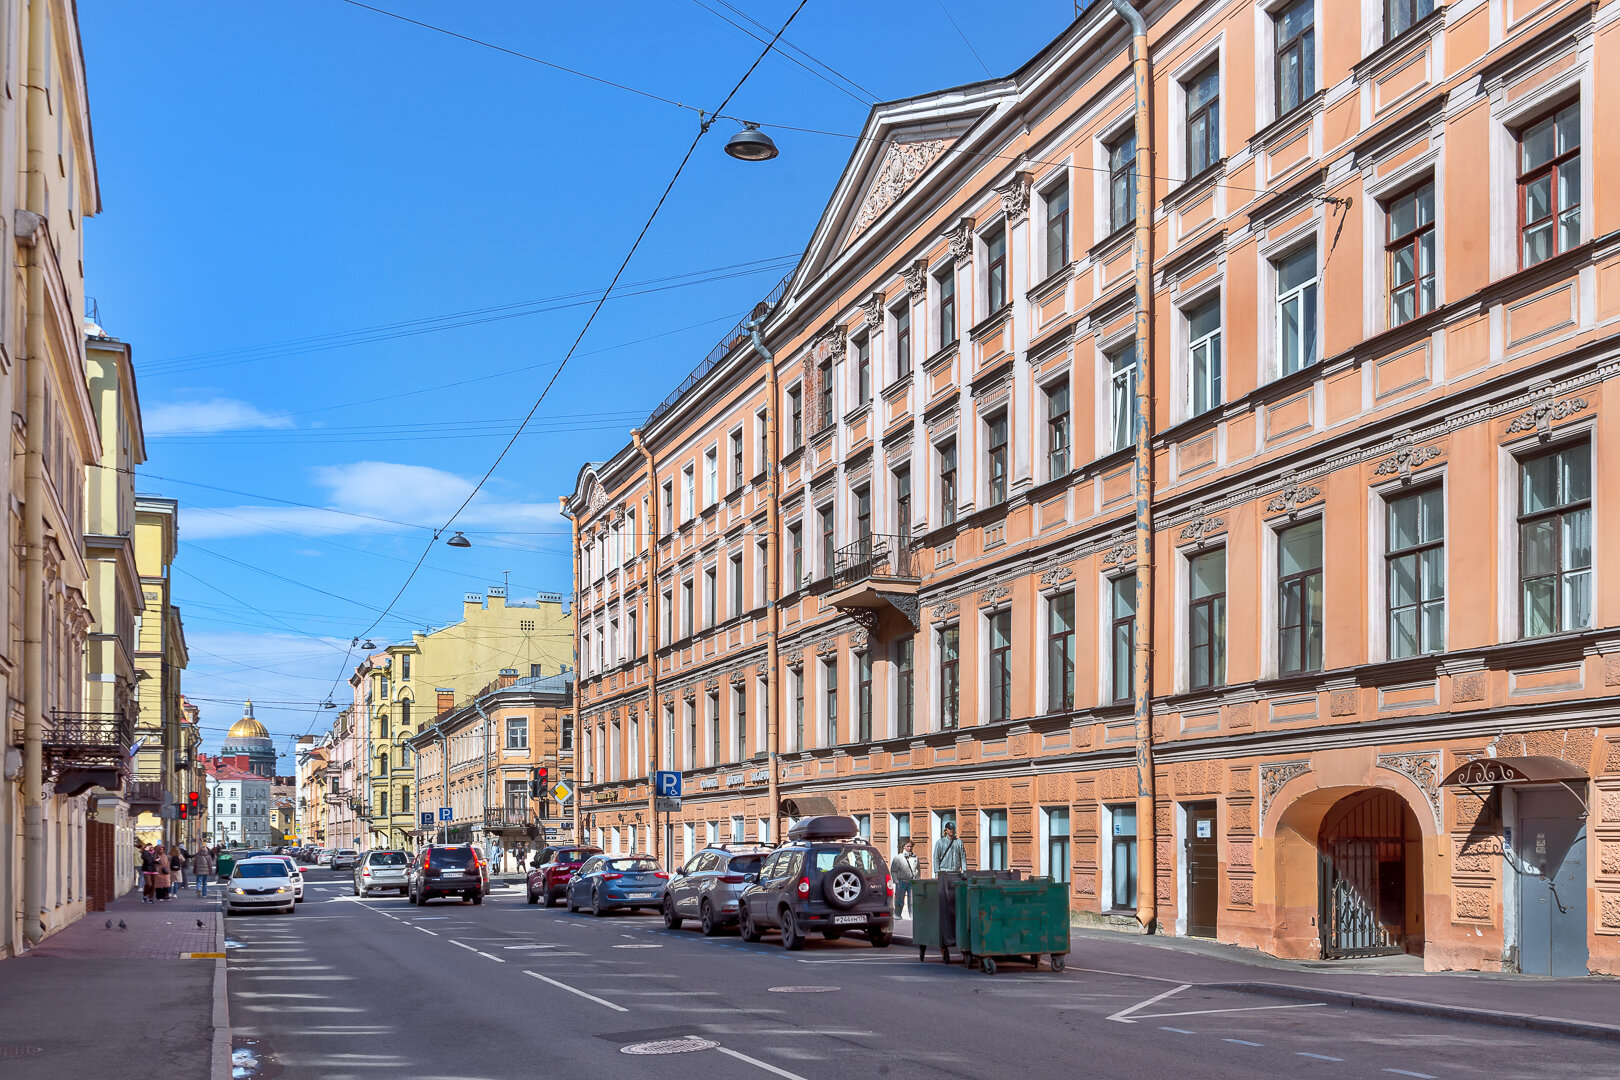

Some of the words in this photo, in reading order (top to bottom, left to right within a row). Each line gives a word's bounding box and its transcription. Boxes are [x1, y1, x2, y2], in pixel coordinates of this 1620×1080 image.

[663, 774, 678, 795] P
[424, 813, 433, 824] P
[442, 809, 451, 820] P
